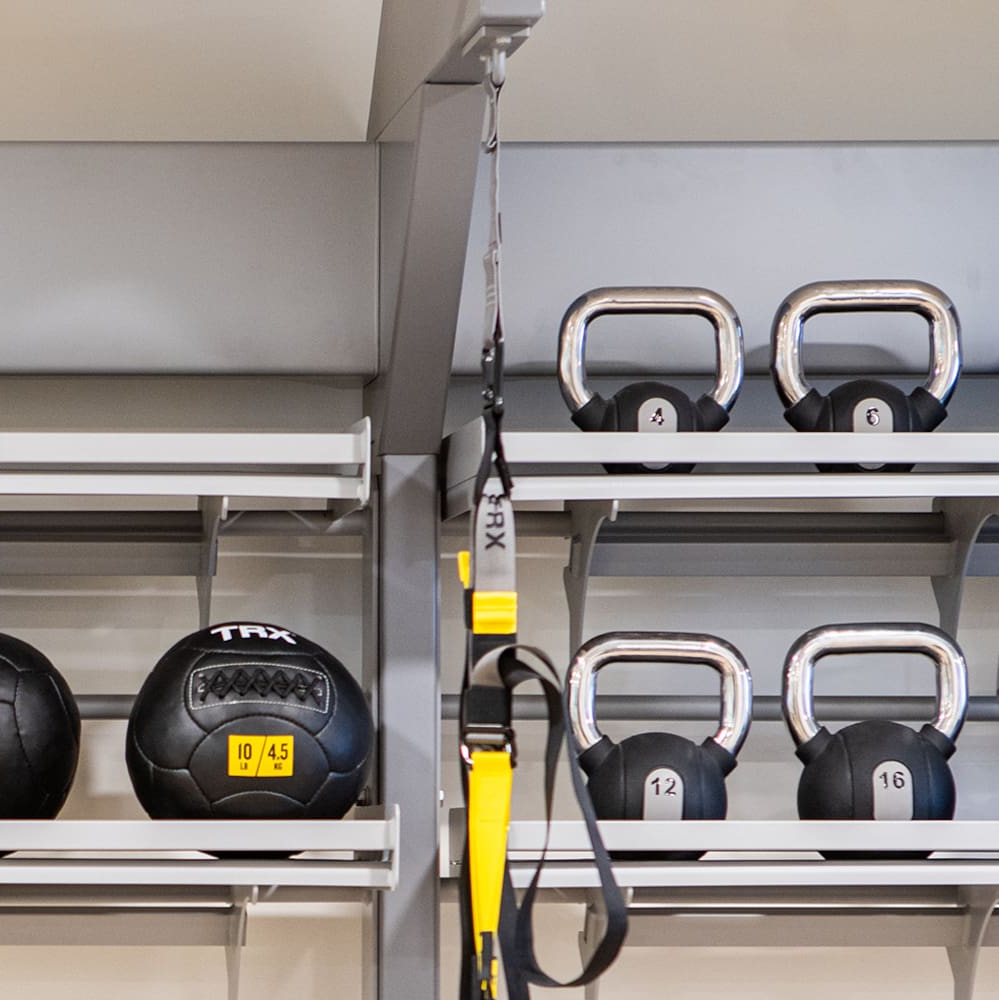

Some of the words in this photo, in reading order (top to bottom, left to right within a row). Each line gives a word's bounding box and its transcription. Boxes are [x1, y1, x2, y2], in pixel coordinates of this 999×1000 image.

[650, 407, 664, 426] 4
[866, 406, 880, 426] 6
[210, 624, 297, 645] TRX
[237, 742, 252, 760] 10
[267, 742, 288, 761] 4.5
[651, 776, 677, 797] 12
[879, 771, 905, 789] 16
